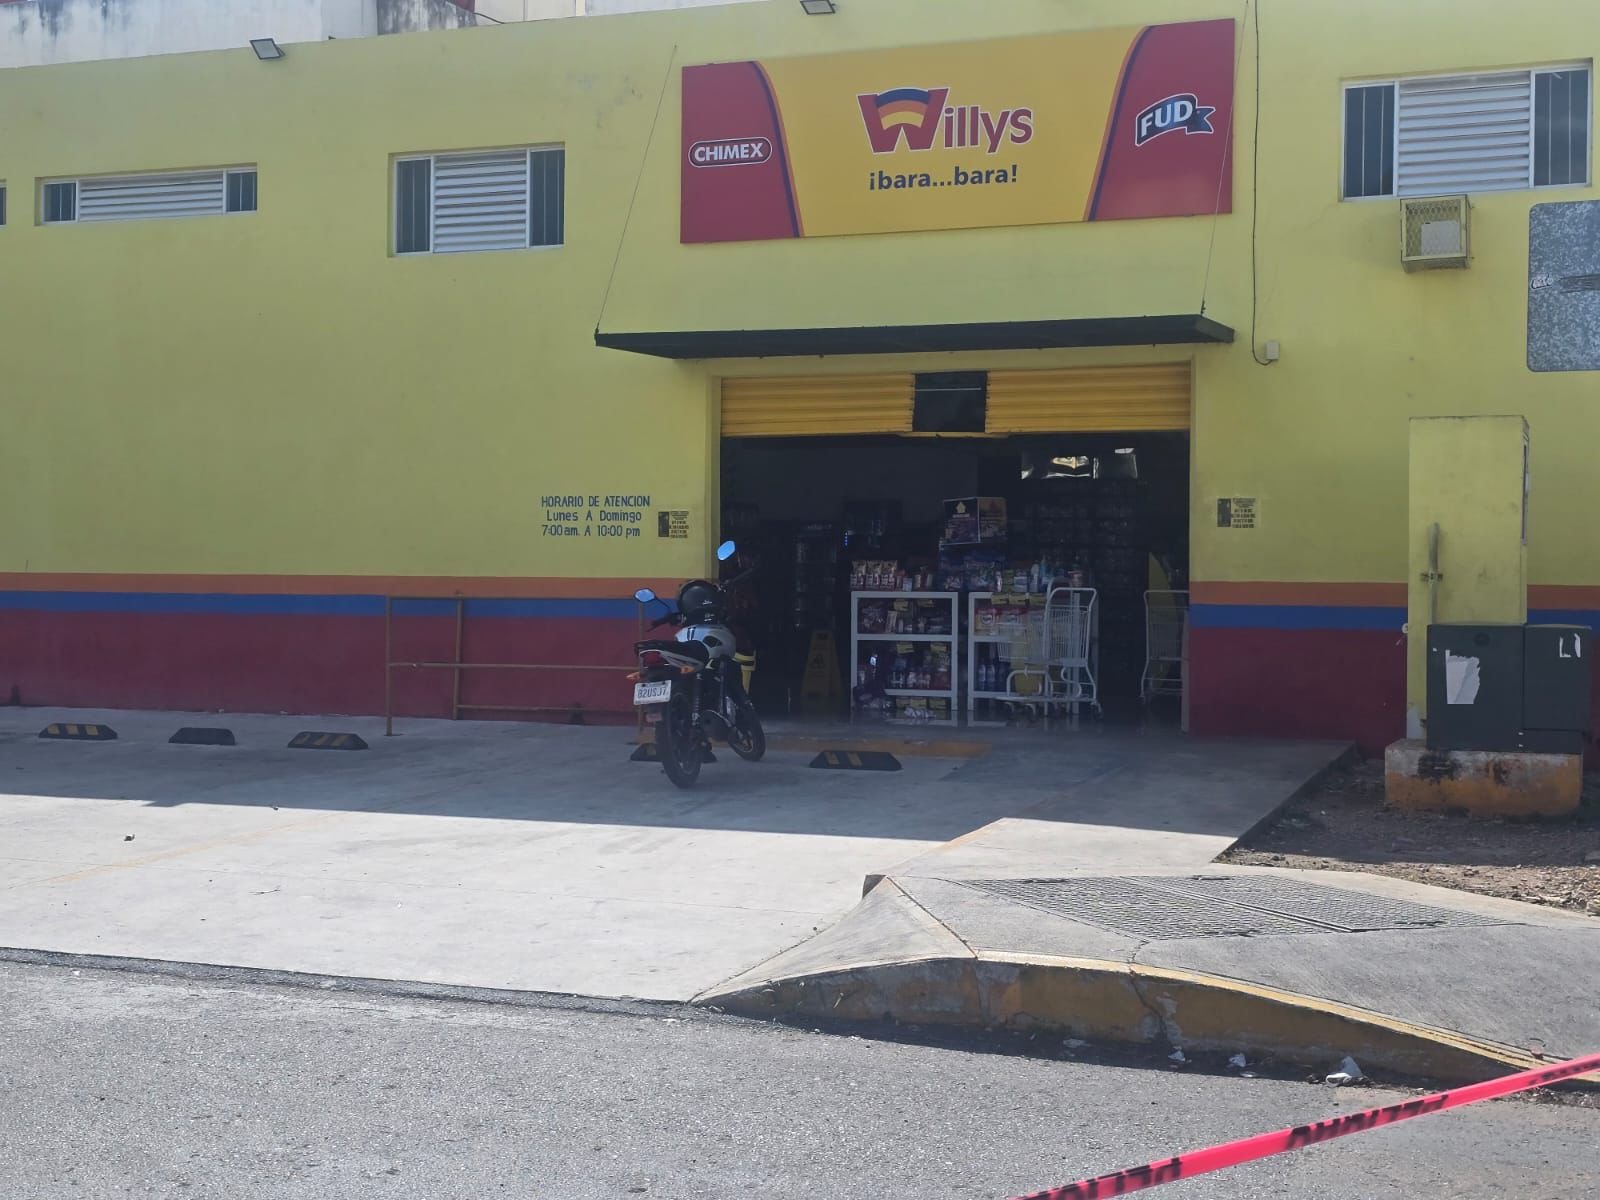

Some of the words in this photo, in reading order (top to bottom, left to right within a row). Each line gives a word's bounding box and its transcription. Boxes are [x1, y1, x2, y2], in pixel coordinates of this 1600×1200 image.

[857, 87, 1033, 155] Willys
[1140, 100, 1193, 138] FUD
[694, 142, 764, 162] CHIMEX
[541, 495, 584, 508] HORARIO
[588, 495, 600, 508] DE
[604, 495, 650, 508] ATENCION
[546, 509, 579, 522] Lunes
[585, 509, 593, 522] A
[599, 509, 642, 523] Domingo
[583, 524, 592, 537] A
[597, 524, 624, 537] 10:00
[625, 527, 641, 540] pm
